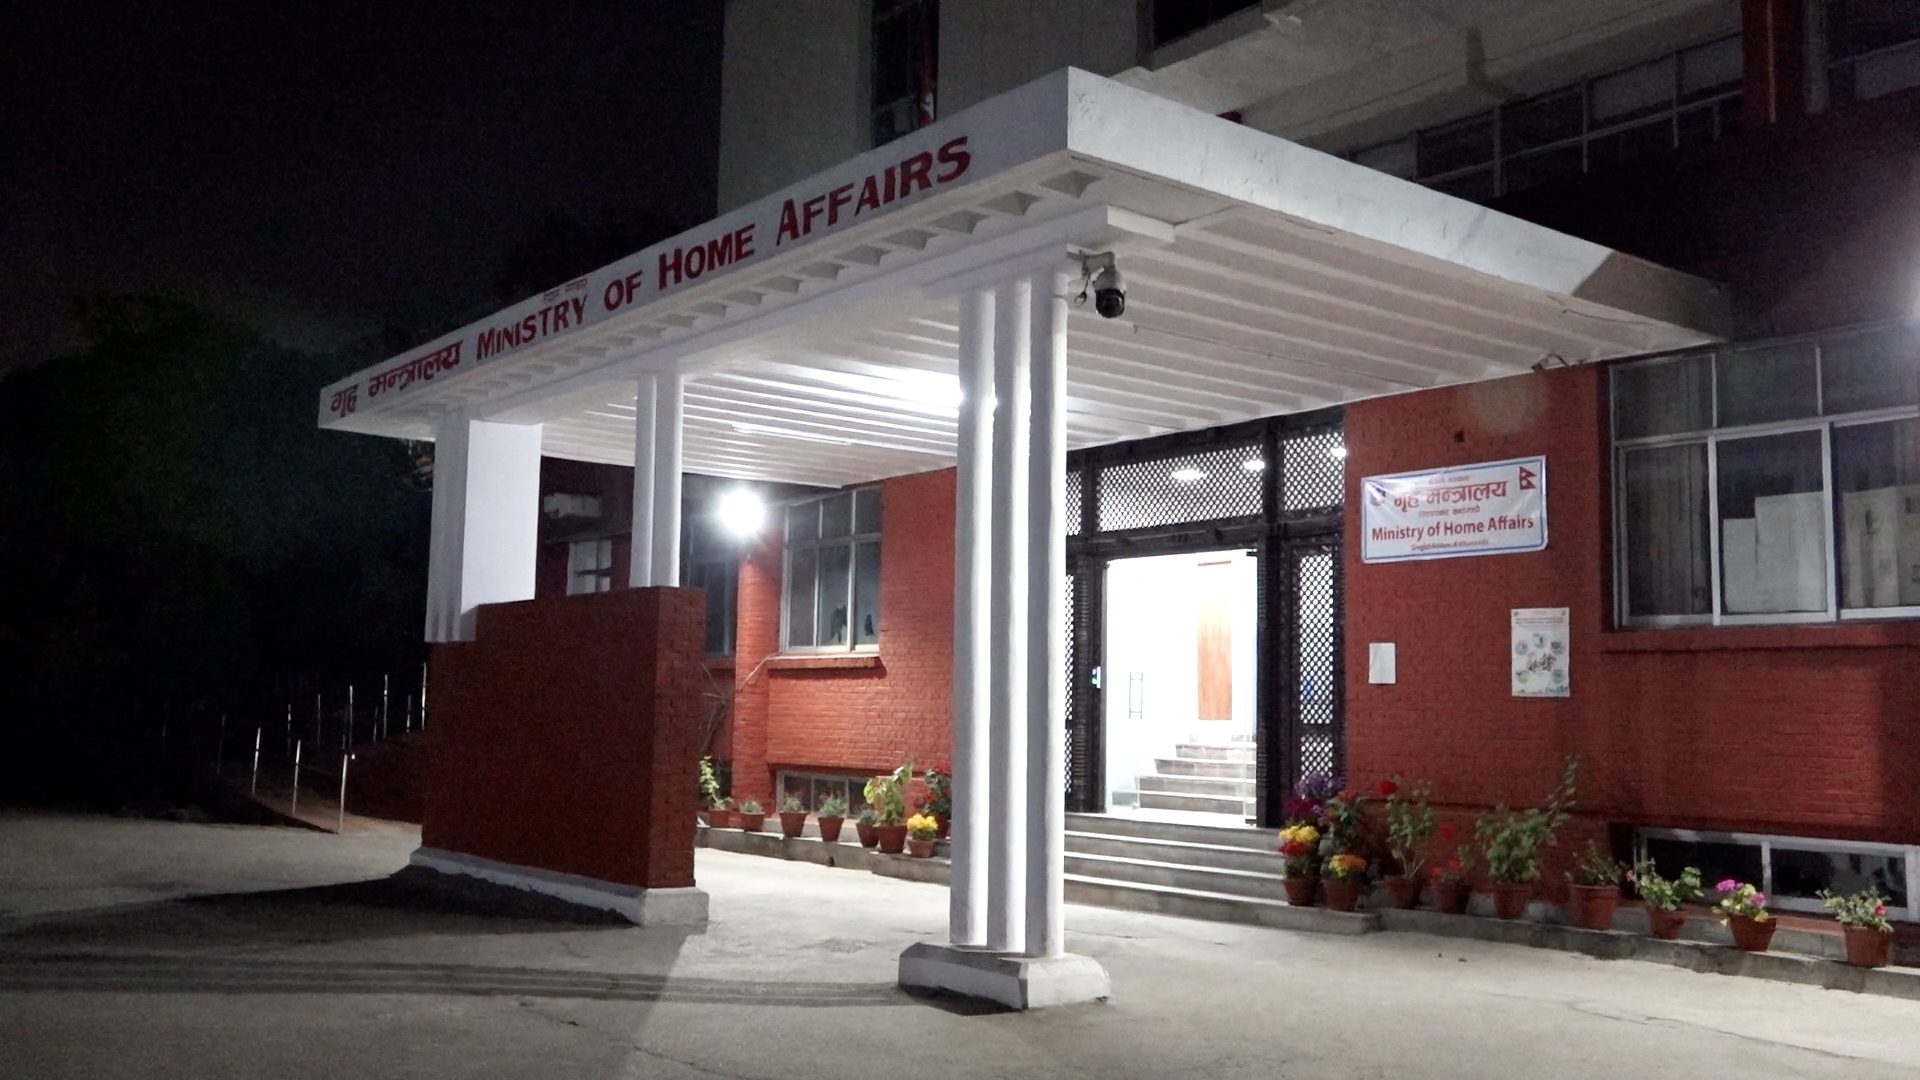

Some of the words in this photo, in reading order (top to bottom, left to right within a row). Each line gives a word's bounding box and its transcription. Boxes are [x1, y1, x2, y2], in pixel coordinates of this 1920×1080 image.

[477, 294, 587, 360] MINISTRY
[603, 270, 642, 311] OF
[658, 223, 755, 290] HOME
[776, 135, 971, 247] AFFAIRS
[330, 383, 360, 418] गृह
[368, 340, 463, 397] मन्त्रालय
[1394, 493, 1419, 513] गृह
[1427, 481, 1508, 505] मन्त्रालय
[1372, 524, 1424, 542] Ministry
[1427, 521, 1440, 537] of
[1444, 520, 1485, 536] Home
[1487, 514, 1534, 531] Affairs
